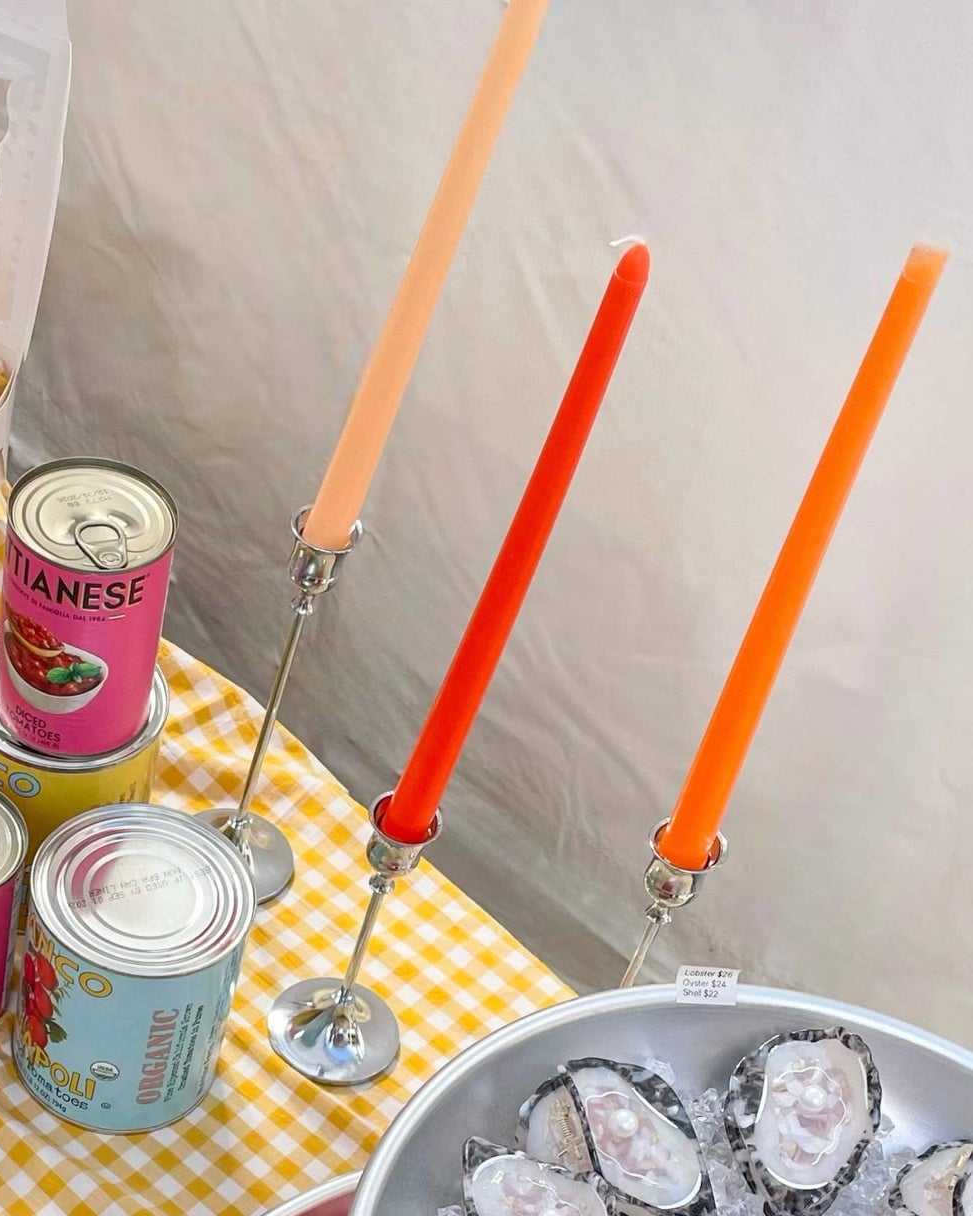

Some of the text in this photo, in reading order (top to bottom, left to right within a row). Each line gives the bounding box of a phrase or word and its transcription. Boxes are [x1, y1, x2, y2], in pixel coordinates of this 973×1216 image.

[15, 705, 47, 729] DICED
[68, 899, 88, 910] 202
[684, 969, 734, 979] Lobster $26
[682, 978, 727, 989] Oyster $24
[682, 988, 719, 999] Shell $22
[136, 1008, 180, 1105] ORGANIC
